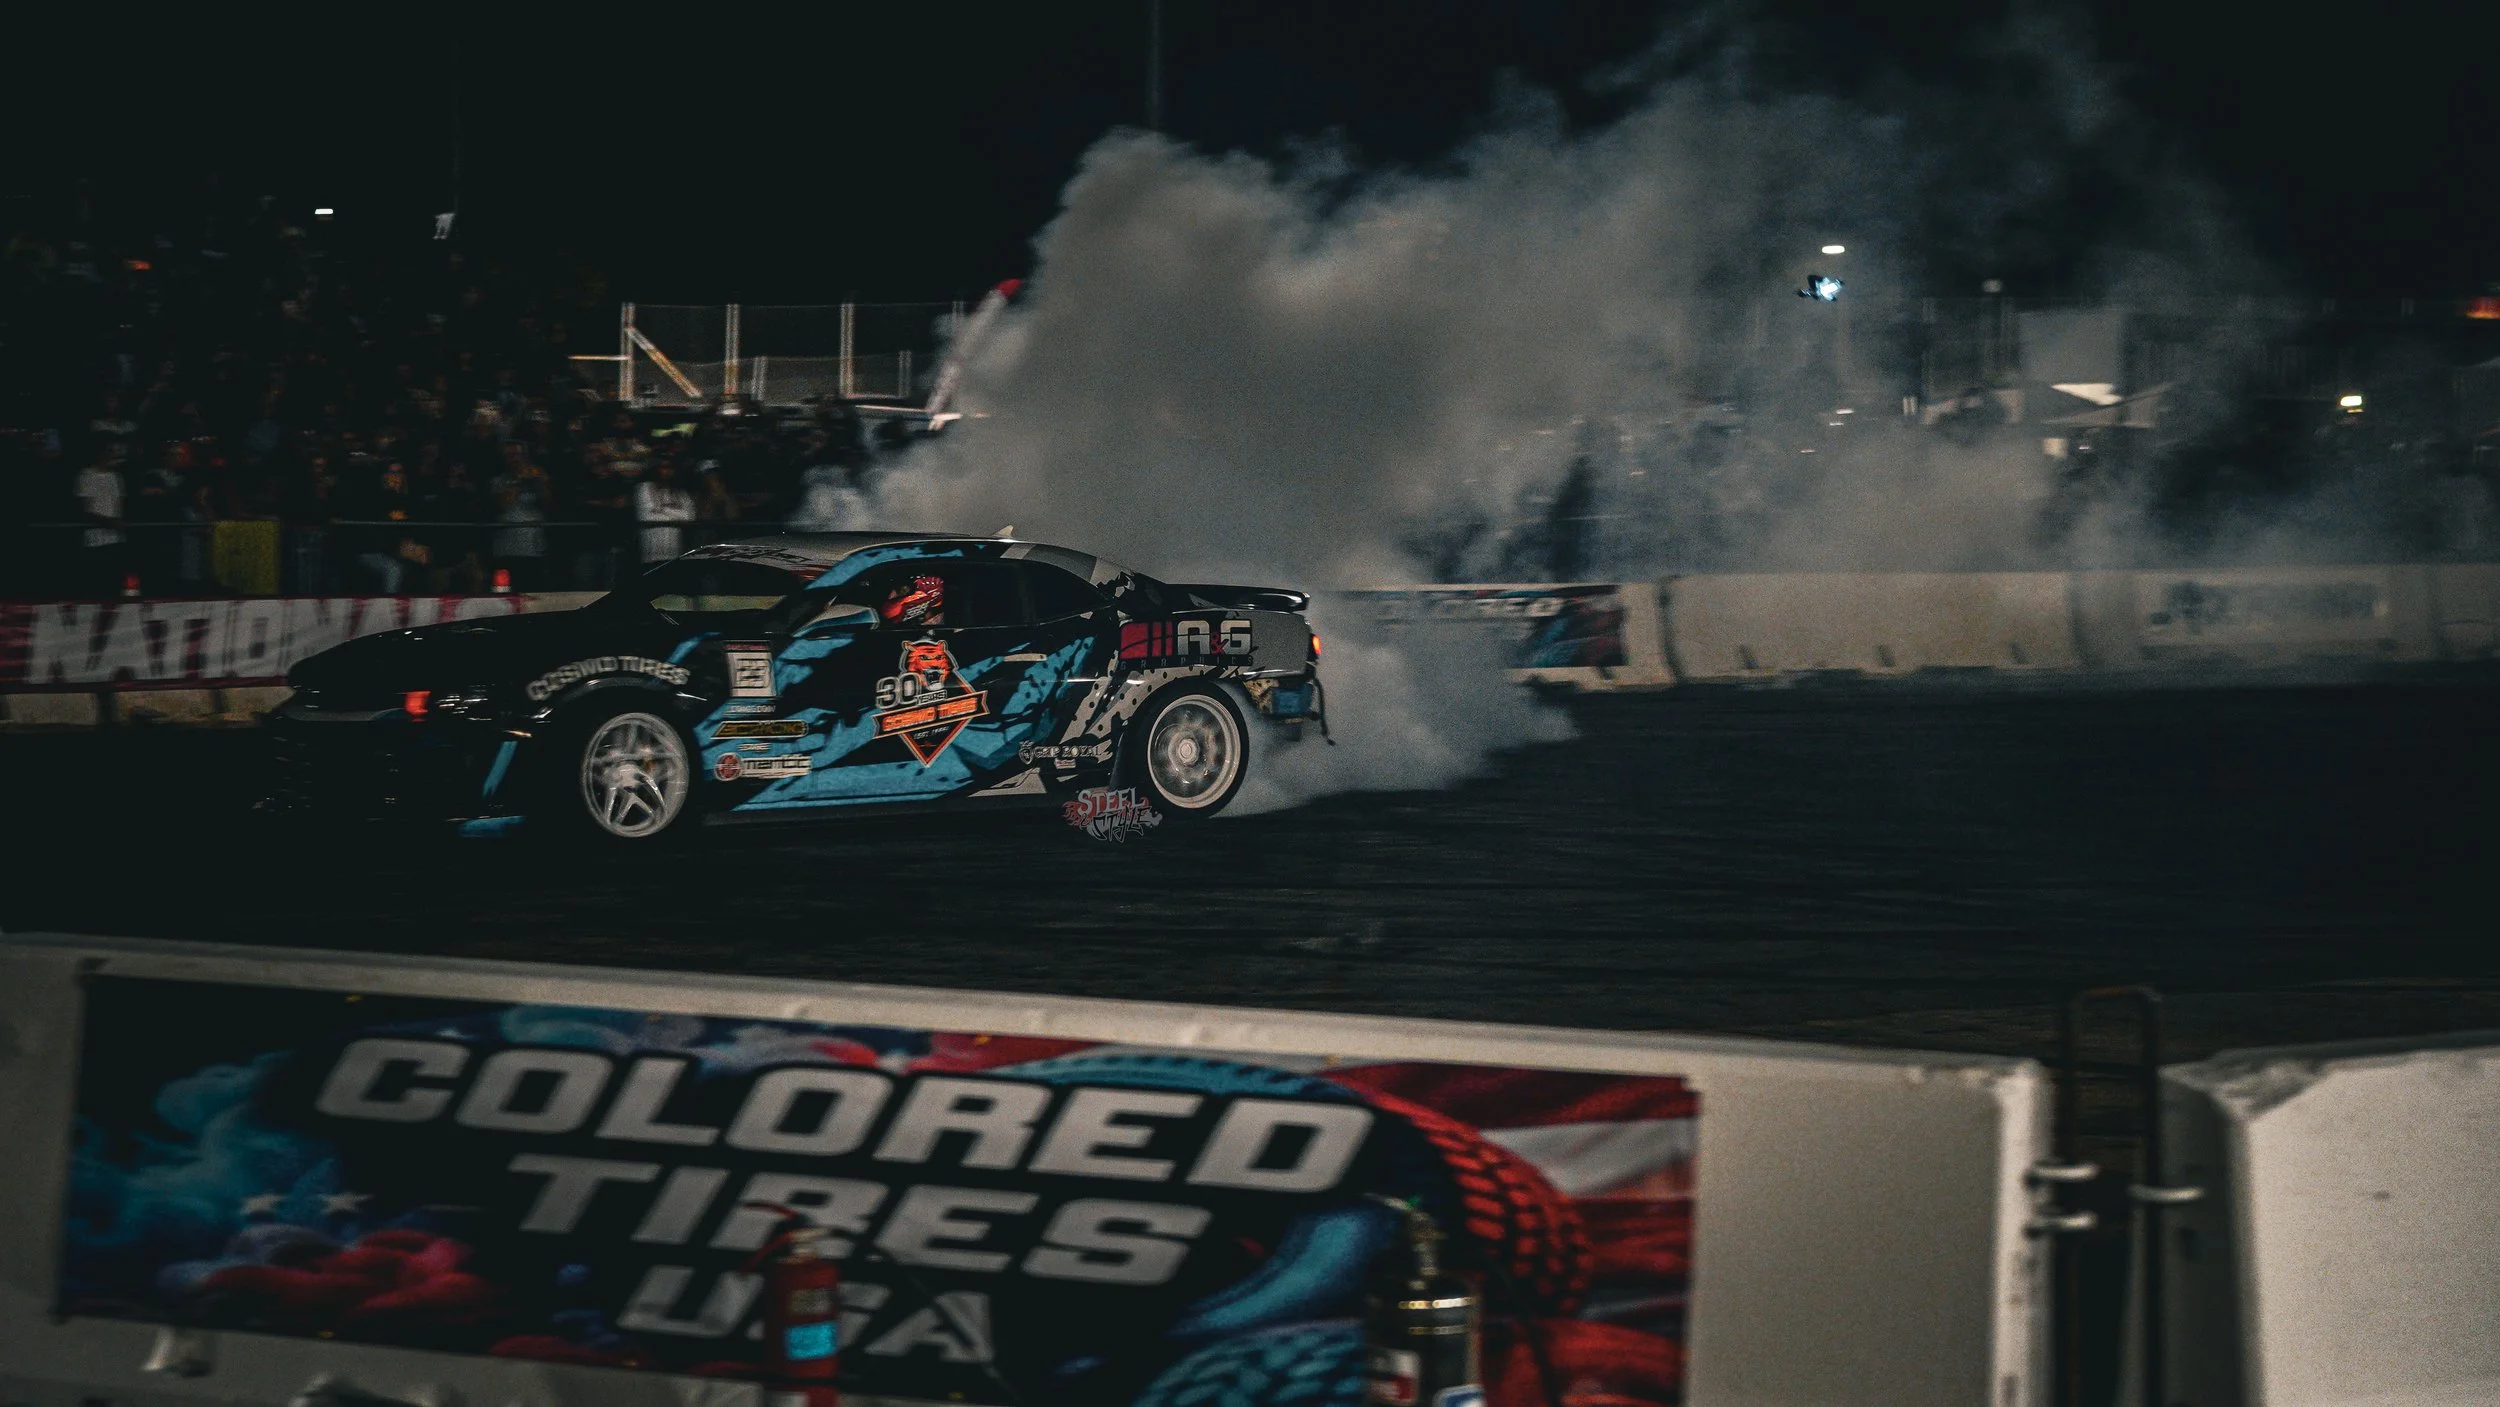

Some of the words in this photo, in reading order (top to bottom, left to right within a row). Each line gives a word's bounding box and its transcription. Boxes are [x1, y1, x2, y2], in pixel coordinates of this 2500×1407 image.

[1177, 620, 1252, 656] A&G
[618, 655, 692, 686] TIRES
[1118, 655, 1254, 671] GRAPHICS
[875, 672, 921, 710] 30
[316, 1037, 1376, 1194] COLORED
[507, 1154, 1212, 1286] TIRES
